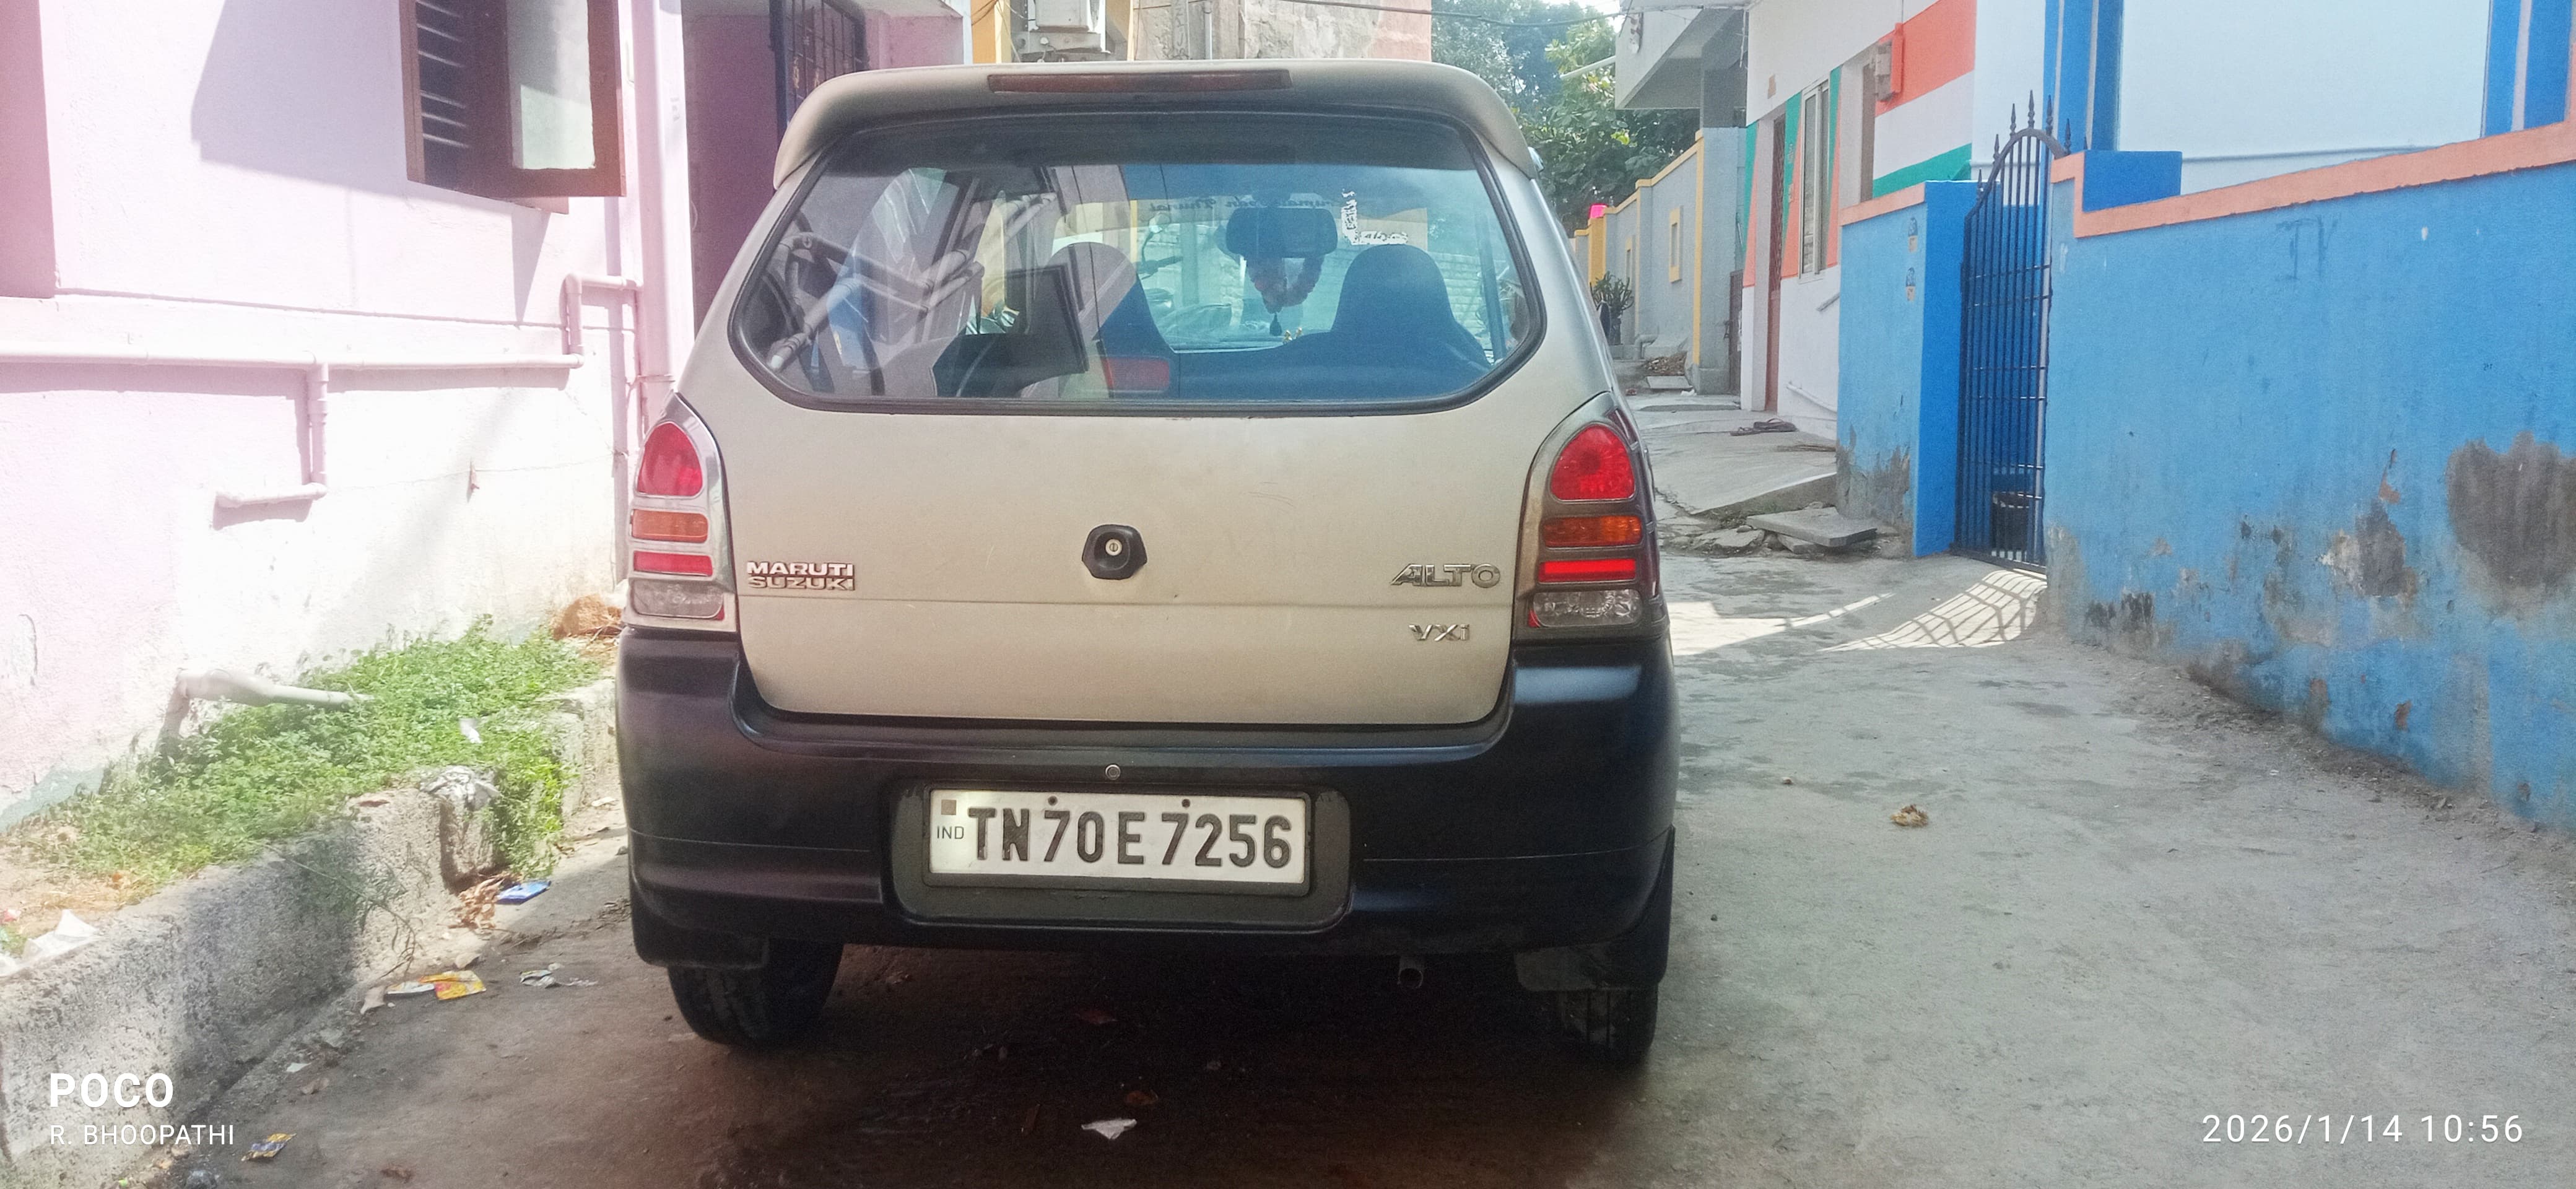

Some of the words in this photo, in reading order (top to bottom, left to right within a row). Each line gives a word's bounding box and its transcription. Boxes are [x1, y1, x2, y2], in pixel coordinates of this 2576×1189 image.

[746, 561, 855, 576] MARUTI
[1391, 563, 1500, 588] ALTO
[747, 577, 855, 590] SUZUKI
[936, 825, 964, 840] IND
[968, 807, 1029, 861] TN
[1043, 809, 1105, 862] 70
[1117, 812, 1146, 865] E
[1161, 813, 1292, 868] 7256
